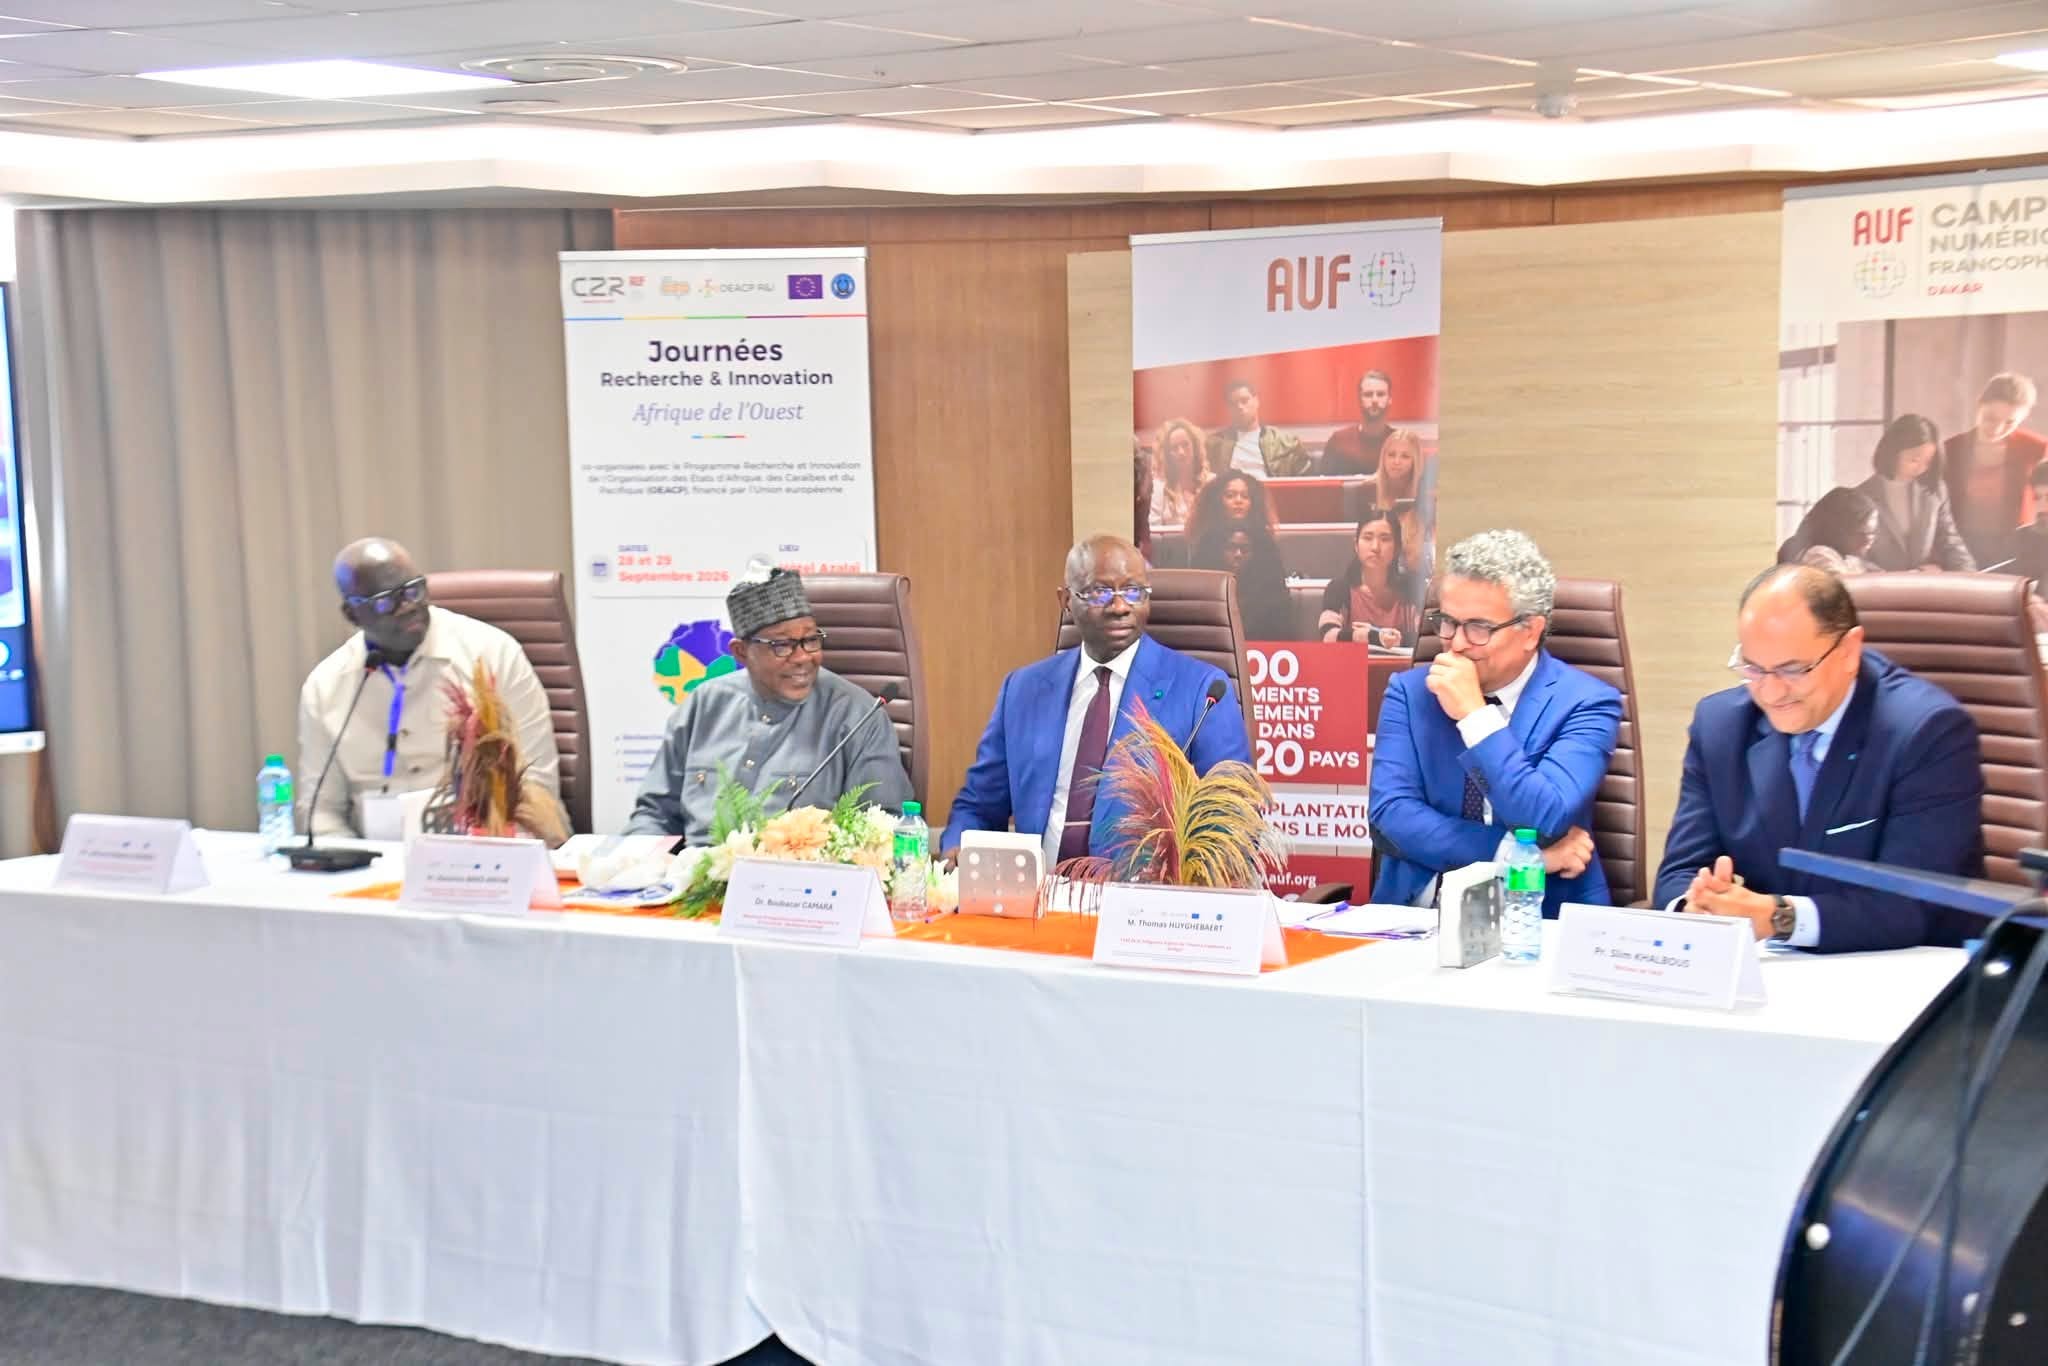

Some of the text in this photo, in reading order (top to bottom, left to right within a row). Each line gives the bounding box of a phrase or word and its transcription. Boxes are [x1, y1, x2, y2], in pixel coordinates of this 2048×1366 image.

[1930, 196, 2047, 228] CAMP
[1853, 206, 1914, 246] AUF
[1267, 254, 1351, 312] AUF
[649, 338, 784, 362] Journées
[601, 370, 834, 387] Recherche & Innovation
[633, 401, 804, 426] Afrique de l'Ouest
[684, 461, 741, 473] Programme
[743, 461, 794, 470] Recherche
[797, 462, 807, 470] et
[810, 461, 860, 470] Innovation
[828, 473, 839, 482] et
[638, 555, 652, 566] et
[618, 571, 693, 583] Septembre
[1251, 686, 1320, 703] MENTS
[1253, 704, 1323, 721] EMENT
[1258, 722, 1315, 739] DANS
[1256, 739, 1360, 776] 20 PAYS
[1305, 823, 1328, 837] LE
[1335, 823, 1367, 838] MO
[1138, 919, 1167, 929] Thomas
